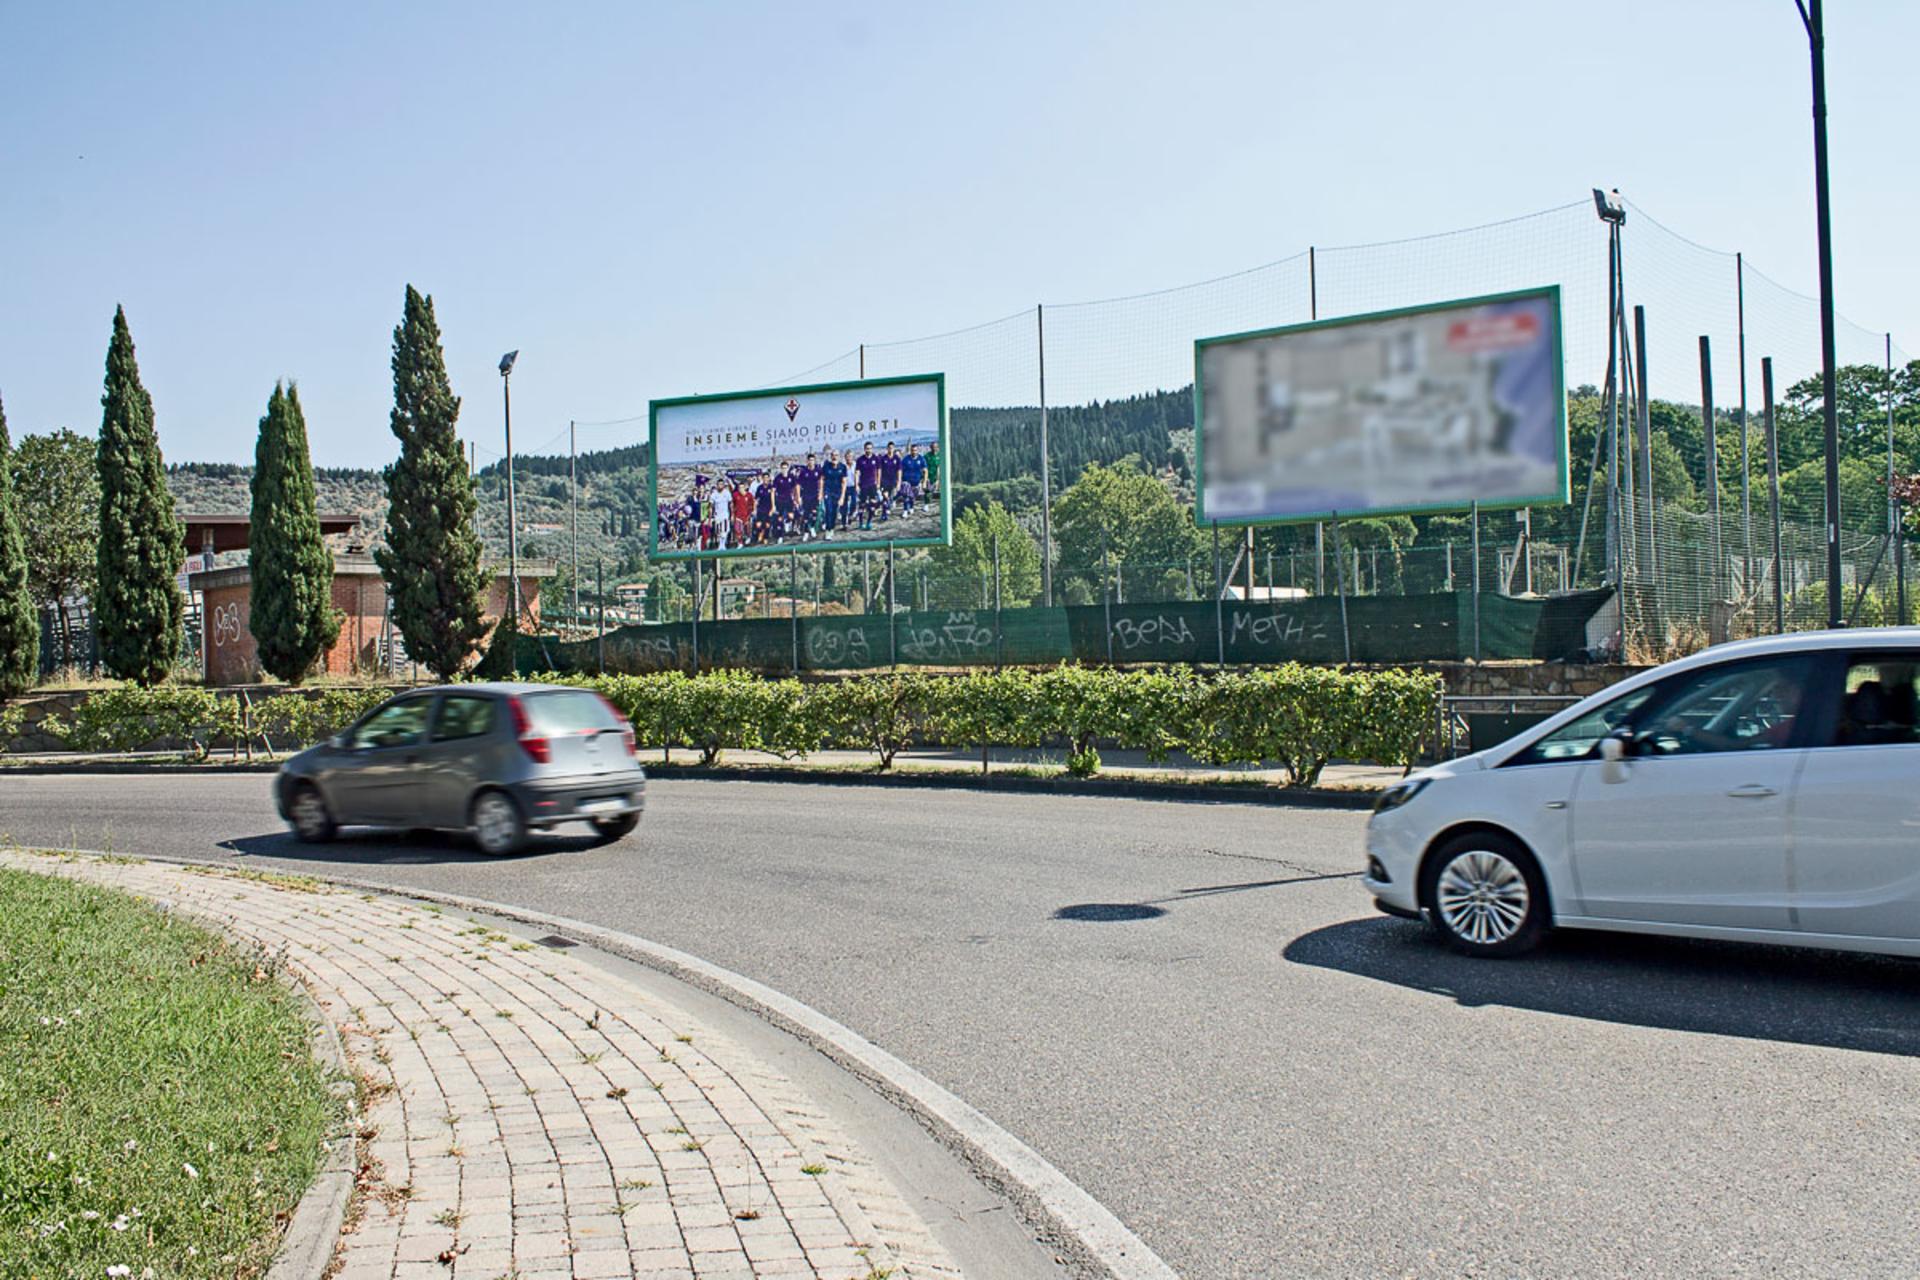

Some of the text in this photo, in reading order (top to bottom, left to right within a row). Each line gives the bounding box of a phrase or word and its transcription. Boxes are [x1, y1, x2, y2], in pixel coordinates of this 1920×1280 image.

[685, 431, 758, 447] INSIEME
[766, 426, 809, 440] SIAMO
[815, 422, 836, 435] PIÙ
[843, 418, 898, 433] FORTI
